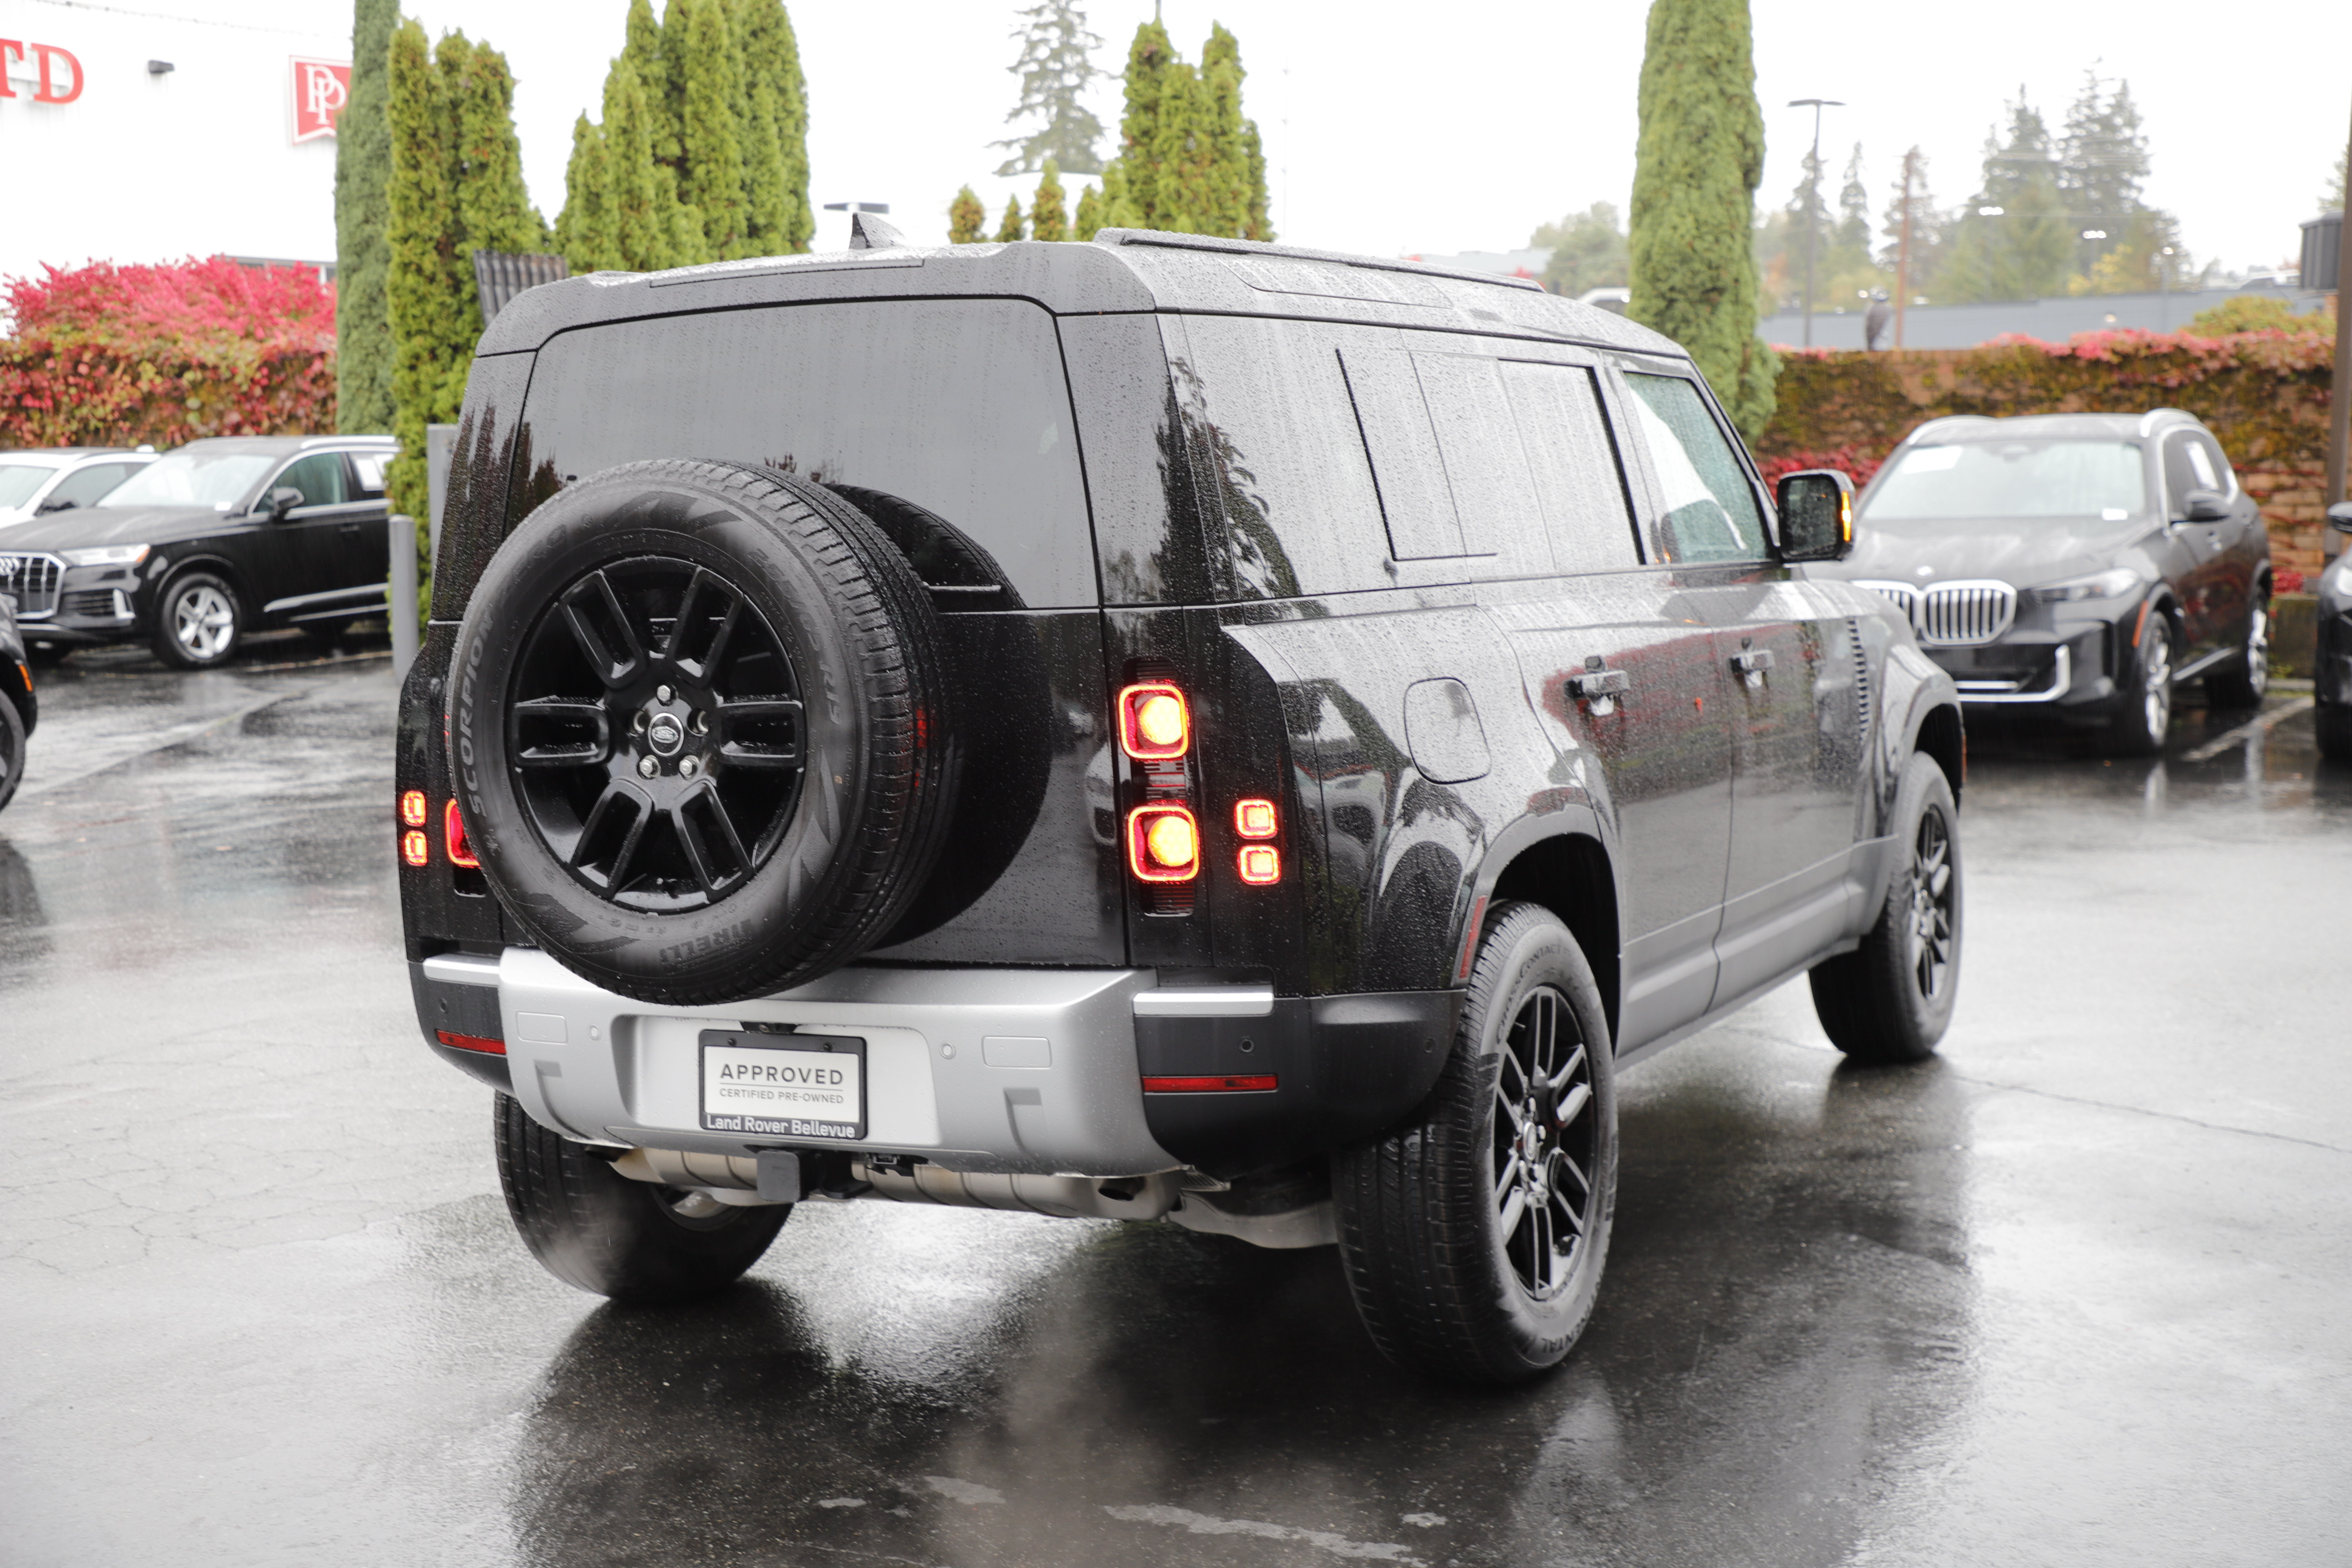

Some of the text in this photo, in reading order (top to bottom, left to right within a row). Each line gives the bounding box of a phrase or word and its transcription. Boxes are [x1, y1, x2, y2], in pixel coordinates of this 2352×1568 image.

[459, 610, 494, 817] SCORPION
[660, 918, 754, 968] PIRELLI
[720, 1065, 842, 1084] APPROVED
[720, 1089, 844, 1103] CERTIFIED PRE-OWNED
[707, 1115, 855, 1138] Land Rover Bellevue
